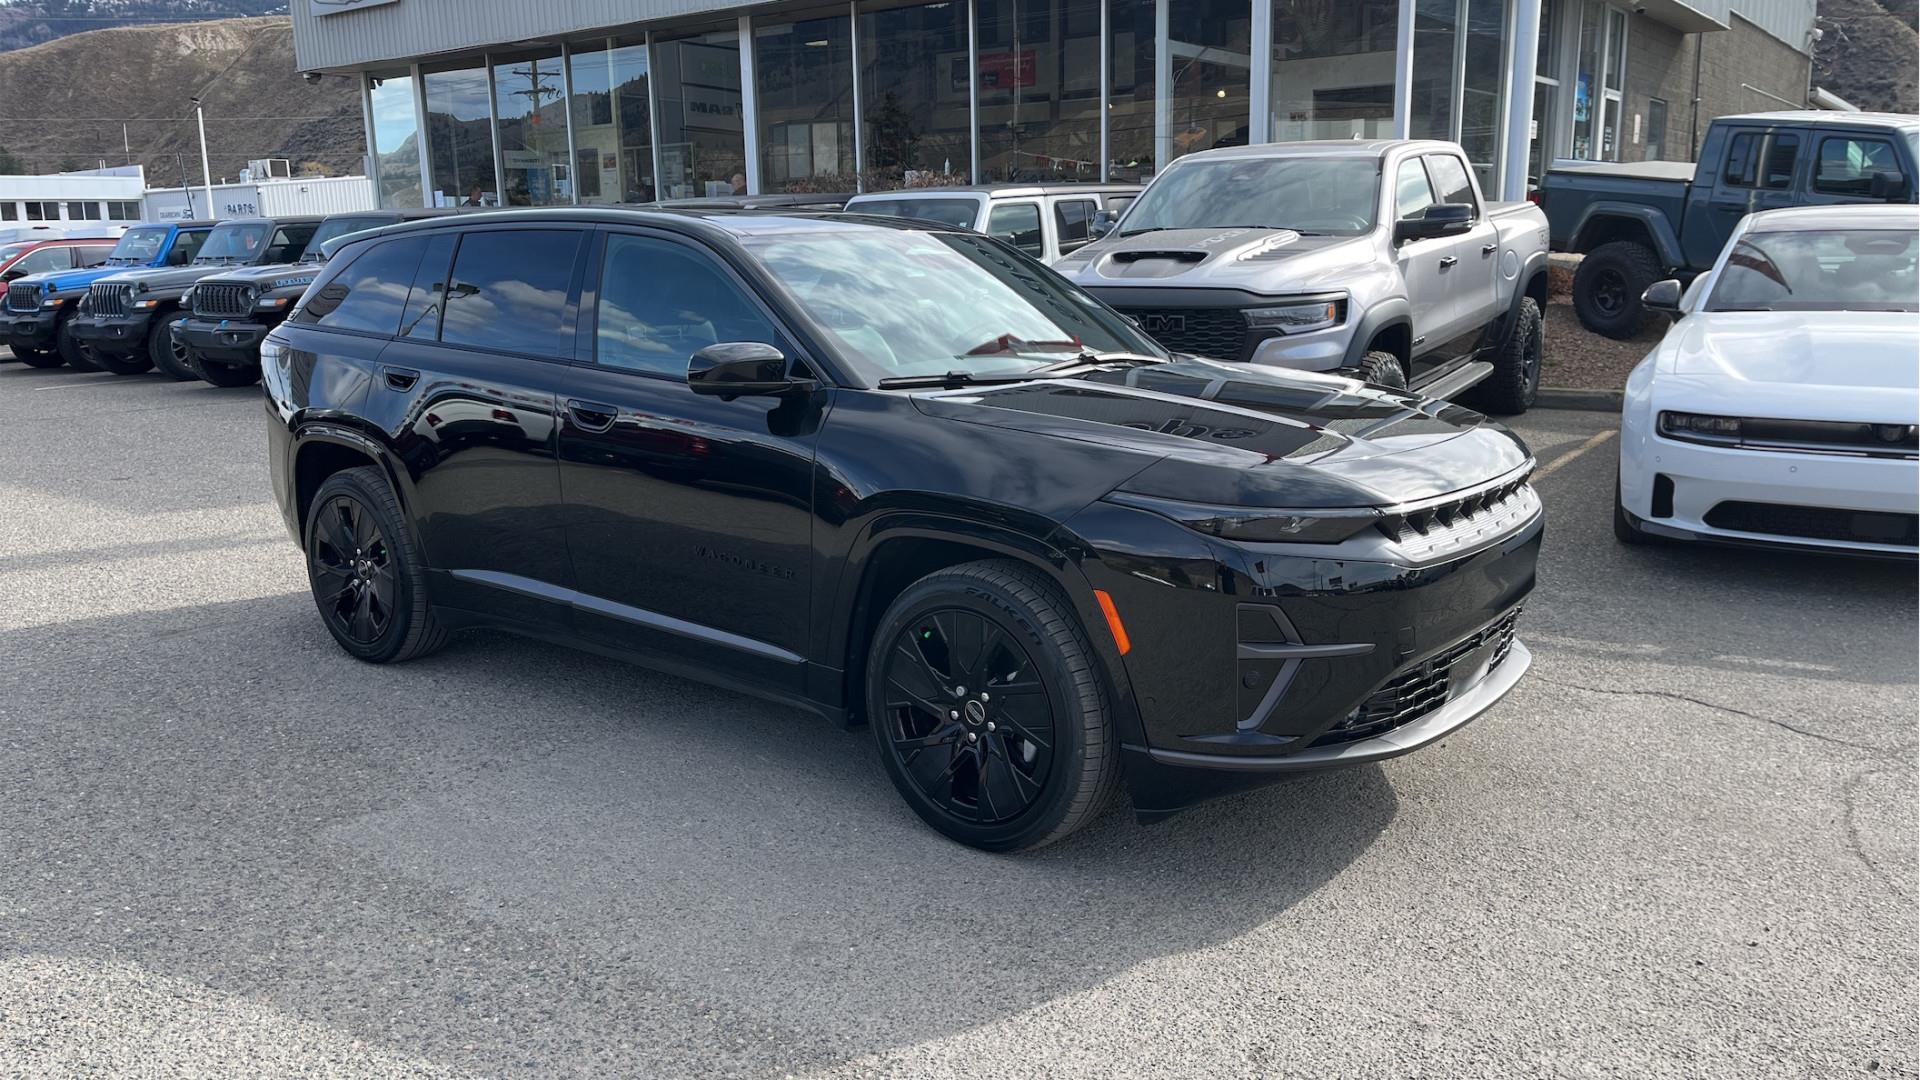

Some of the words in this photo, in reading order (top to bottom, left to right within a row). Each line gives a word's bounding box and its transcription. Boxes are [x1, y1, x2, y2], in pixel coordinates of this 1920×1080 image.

[228, 203, 253, 214] PARTS
[1126, 314, 1185, 331] AM
[695, 544, 794, 579] WAGONEER
